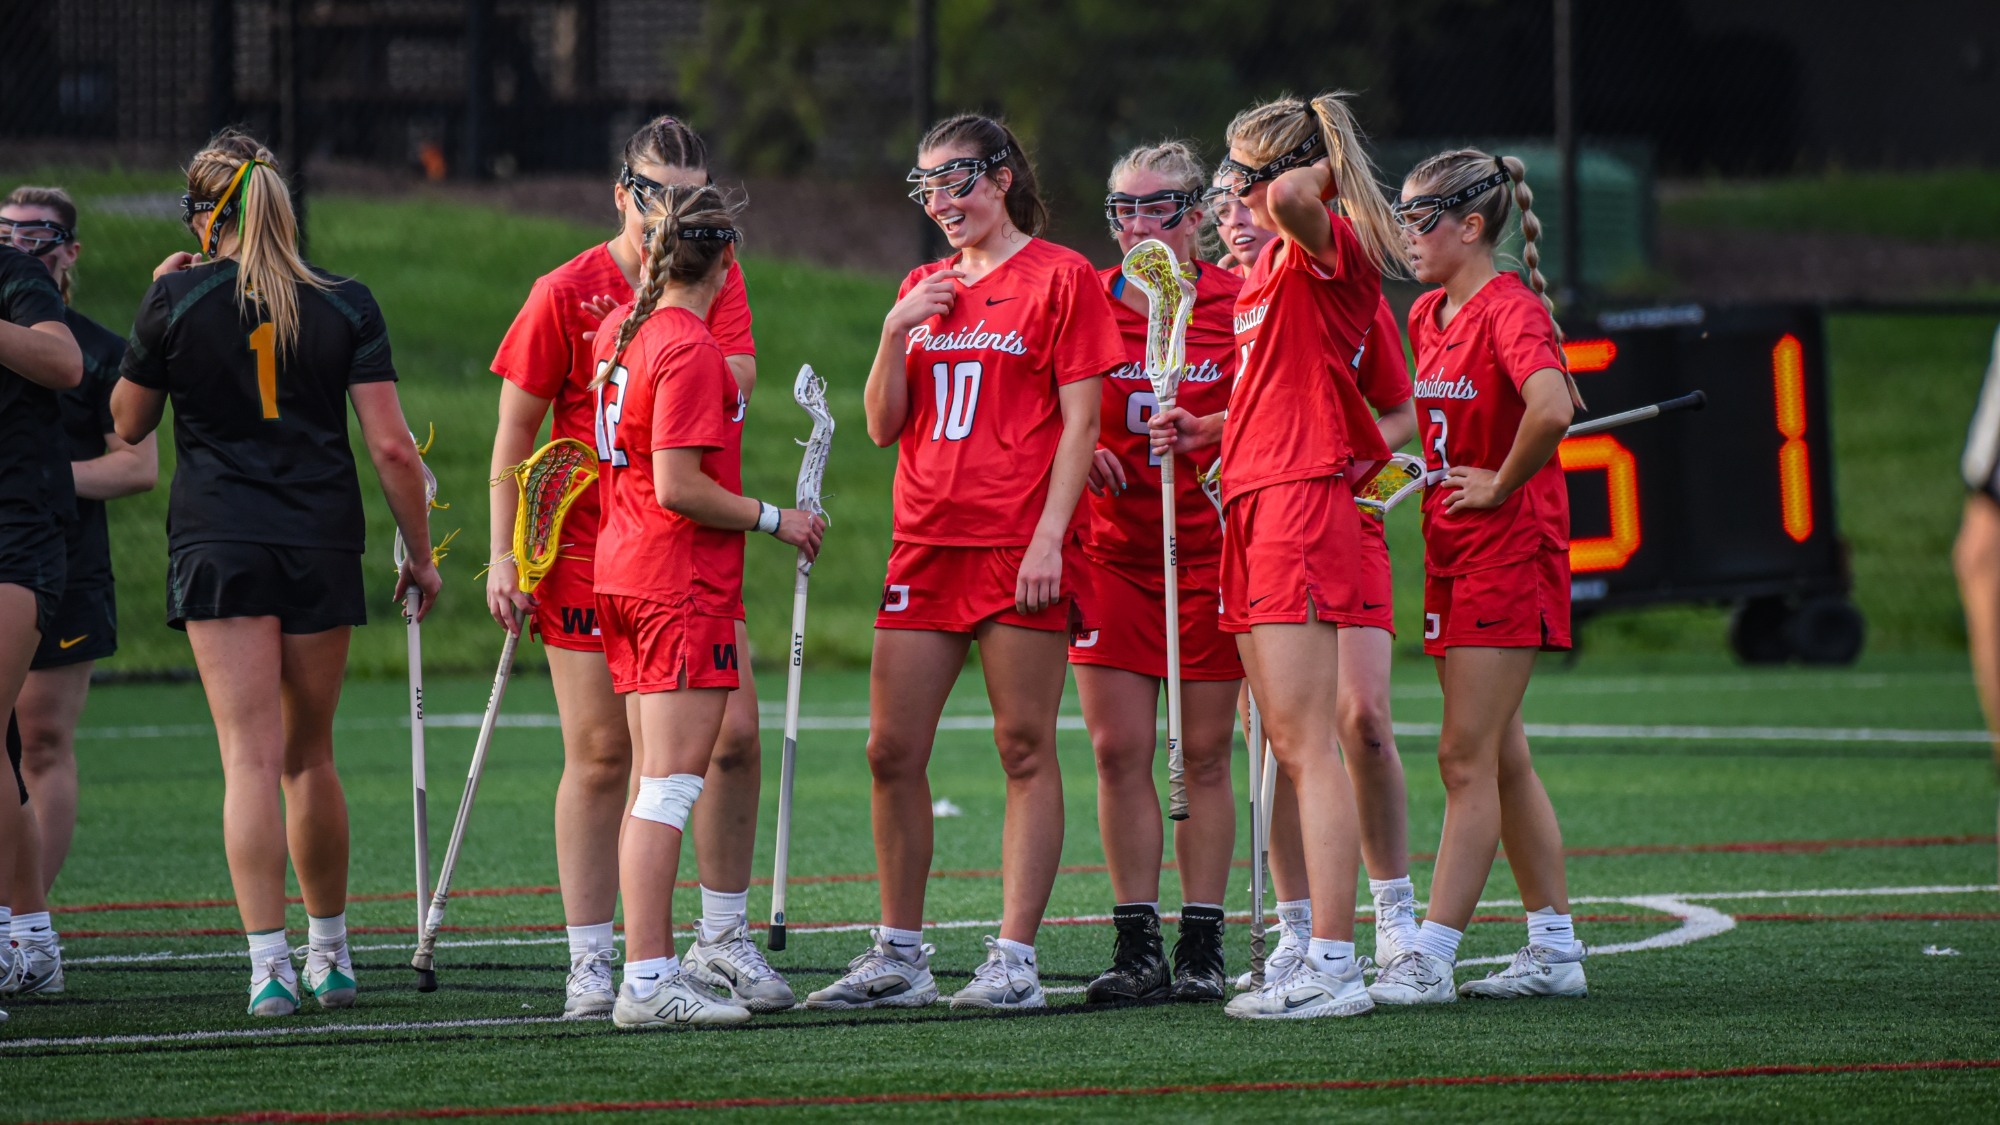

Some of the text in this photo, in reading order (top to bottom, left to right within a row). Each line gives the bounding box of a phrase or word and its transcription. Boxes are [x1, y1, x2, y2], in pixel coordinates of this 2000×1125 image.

[990, 149, 1007, 164] STX
[1269, 151, 1297, 173] STX
[1466, 180, 1491, 197] STX
[194, 201, 216, 211] STX
[905, 319, 1028, 356] Presidents
[249, 322, 281, 420] 1
[1414, 366, 1478, 399] residents
[595, 359, 630, 468] 12
[931, 360, 983, 442] 10
[1426, 408, 1451, 486] 3
[1169, 535, 1177, 566] GAIT
[793, 632, 803, 667] GAIT
